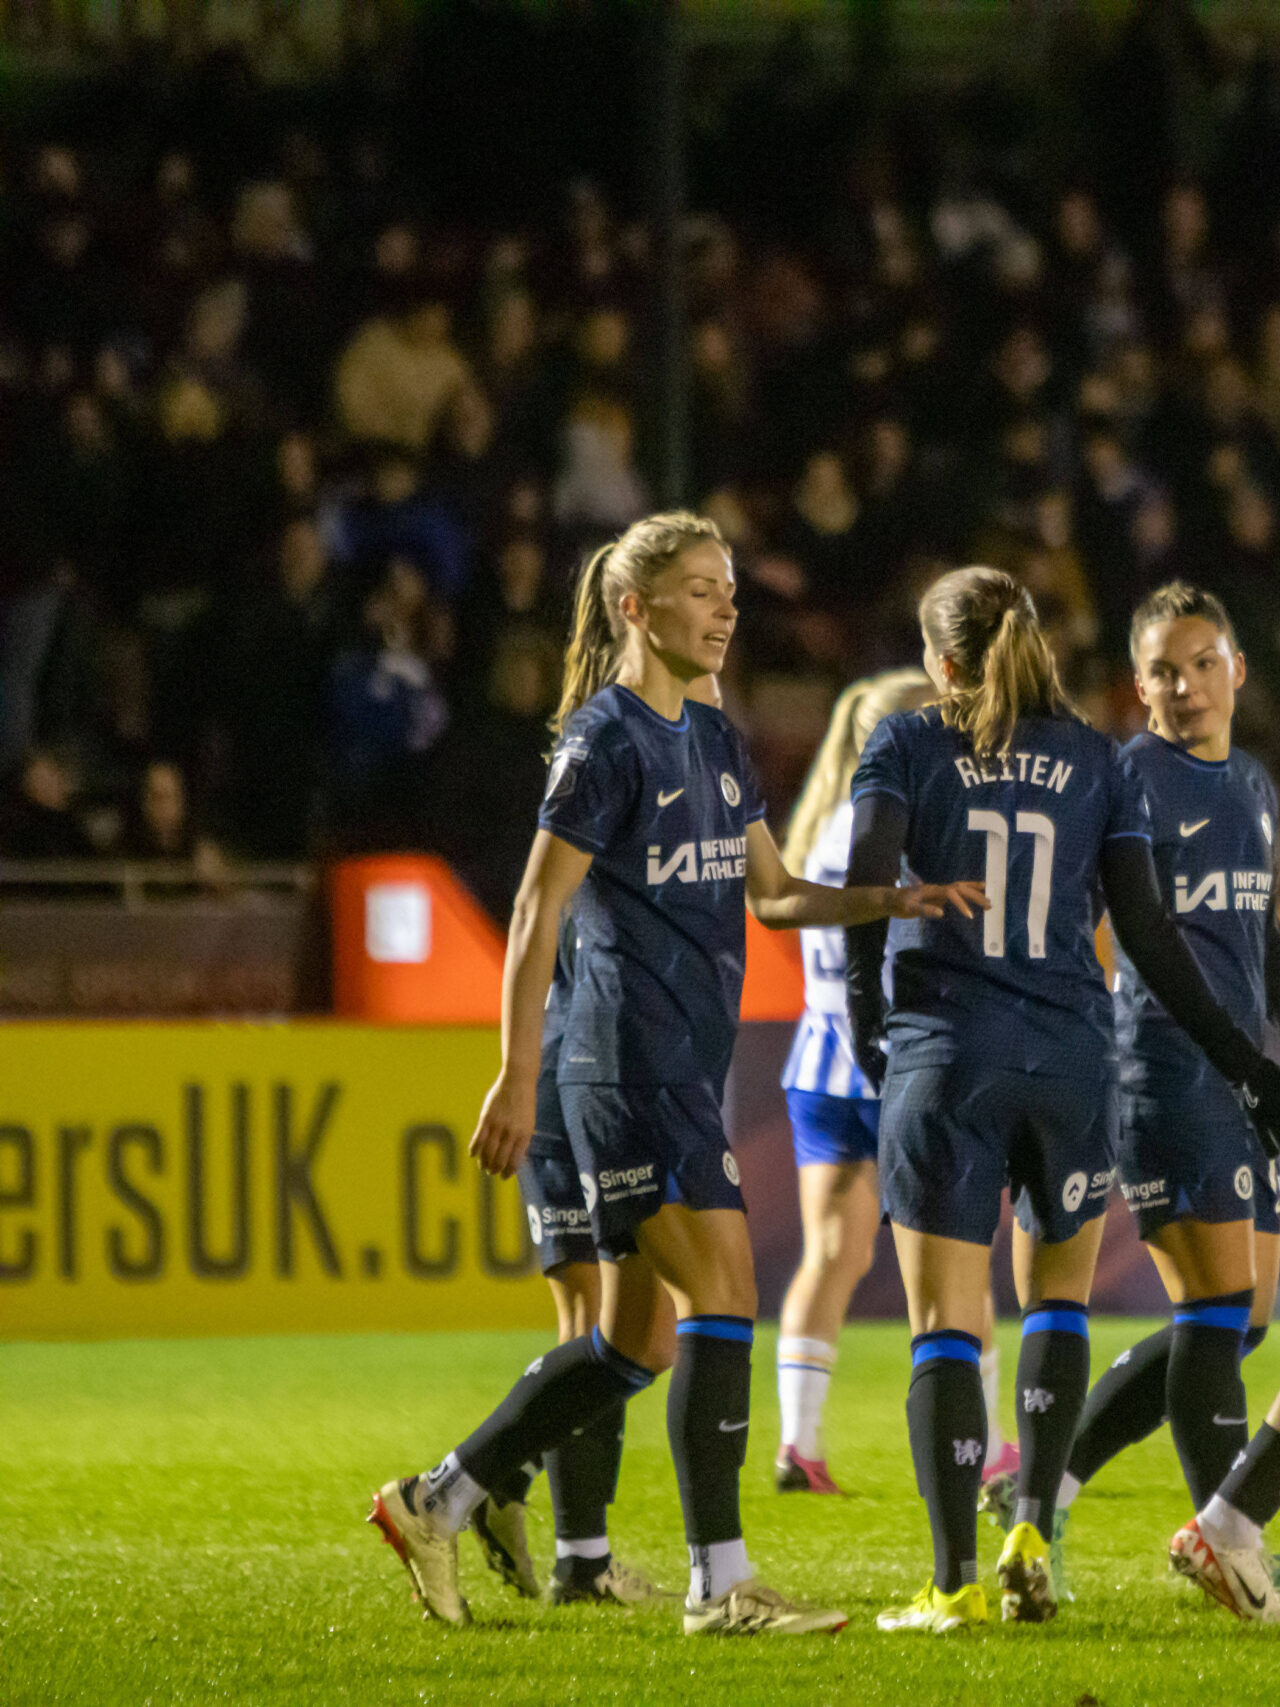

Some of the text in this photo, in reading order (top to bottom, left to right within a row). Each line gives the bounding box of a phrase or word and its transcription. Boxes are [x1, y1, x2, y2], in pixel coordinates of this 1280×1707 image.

[954, 751, 1073, 795] REITEN
[967, 809, 1055, 959] 11
[598, 1164, 655, 1189] Singer
